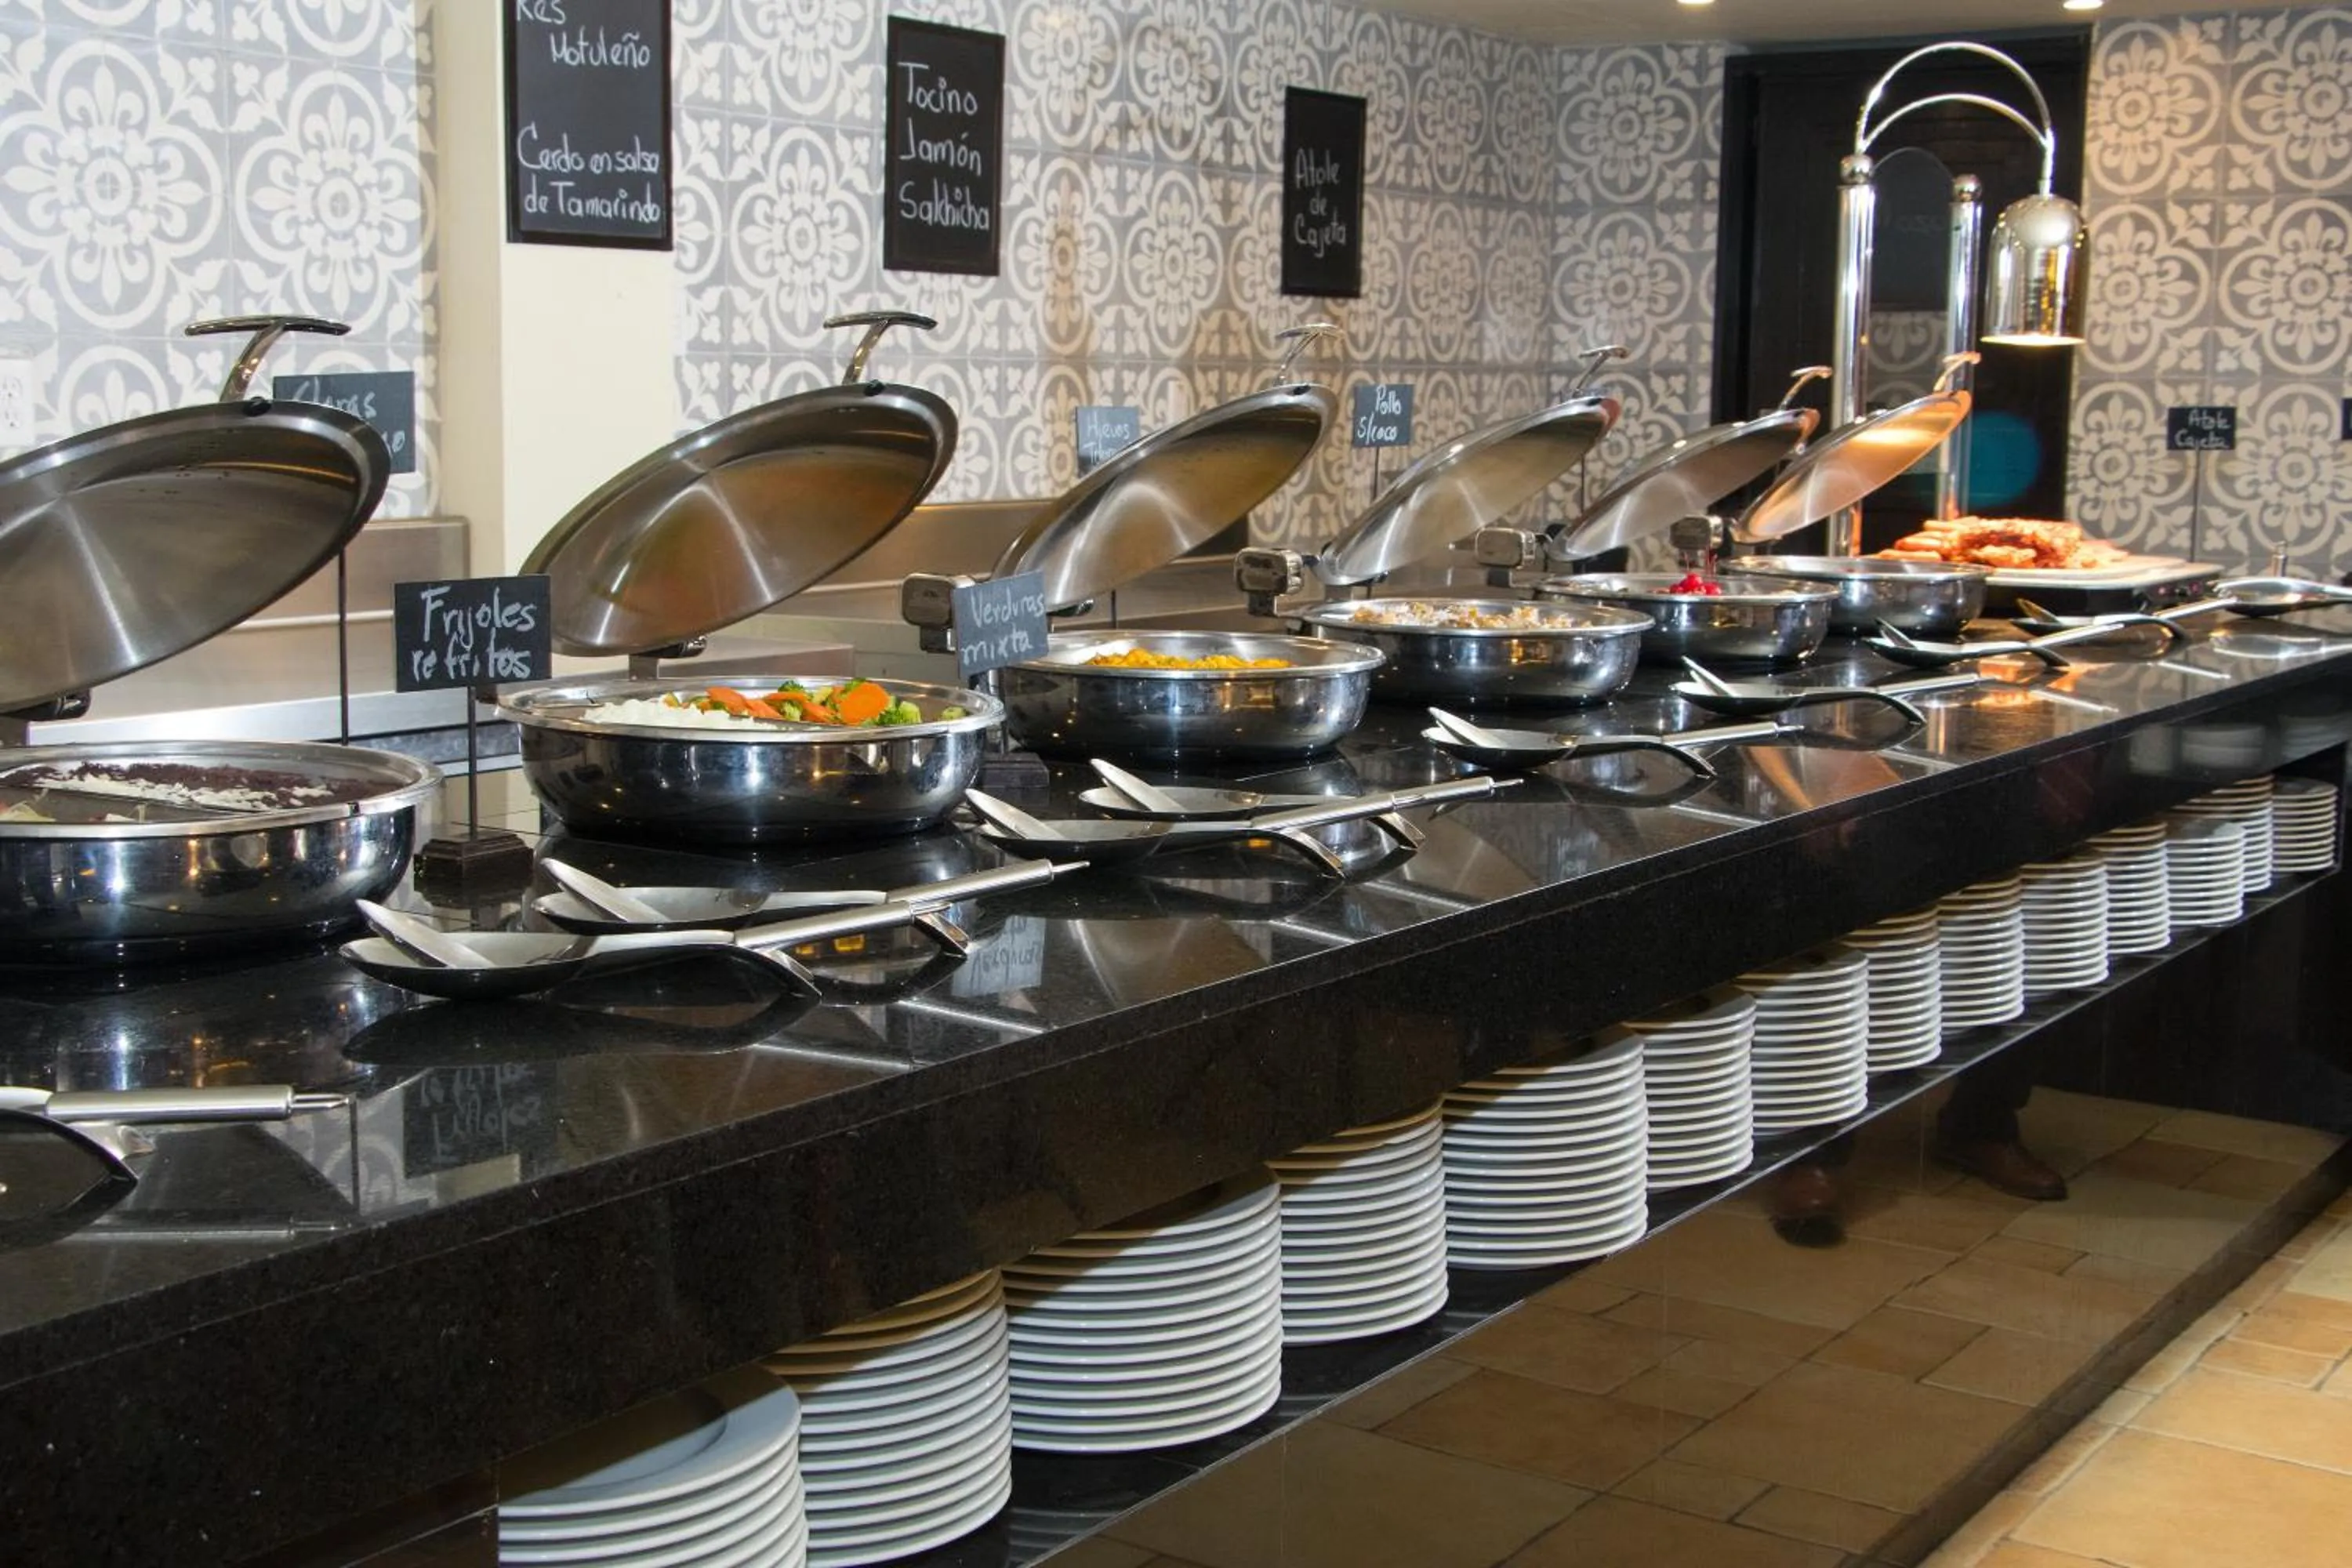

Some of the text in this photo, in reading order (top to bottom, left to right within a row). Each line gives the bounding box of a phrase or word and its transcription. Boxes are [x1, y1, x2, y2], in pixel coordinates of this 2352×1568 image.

[549, 25, 651, 68] Motuleño
[897, 61, 978, 116] Tocino
[517, 122, 660, 175] Cerdo en salsa
[898, 117, 983, 177] Jamón
[1295, 147, 1341, 189] Atole
[524, 173, 662, 223] de Tamarindo
[898, 177, 990, 230] Salchicha
[1308, 191, 1328, 216] de
[1294, 205, 1347, 260] Cajeta
[970, 586, 1046, 629] Verduras
[960, 623, 1034, 666] mixta
